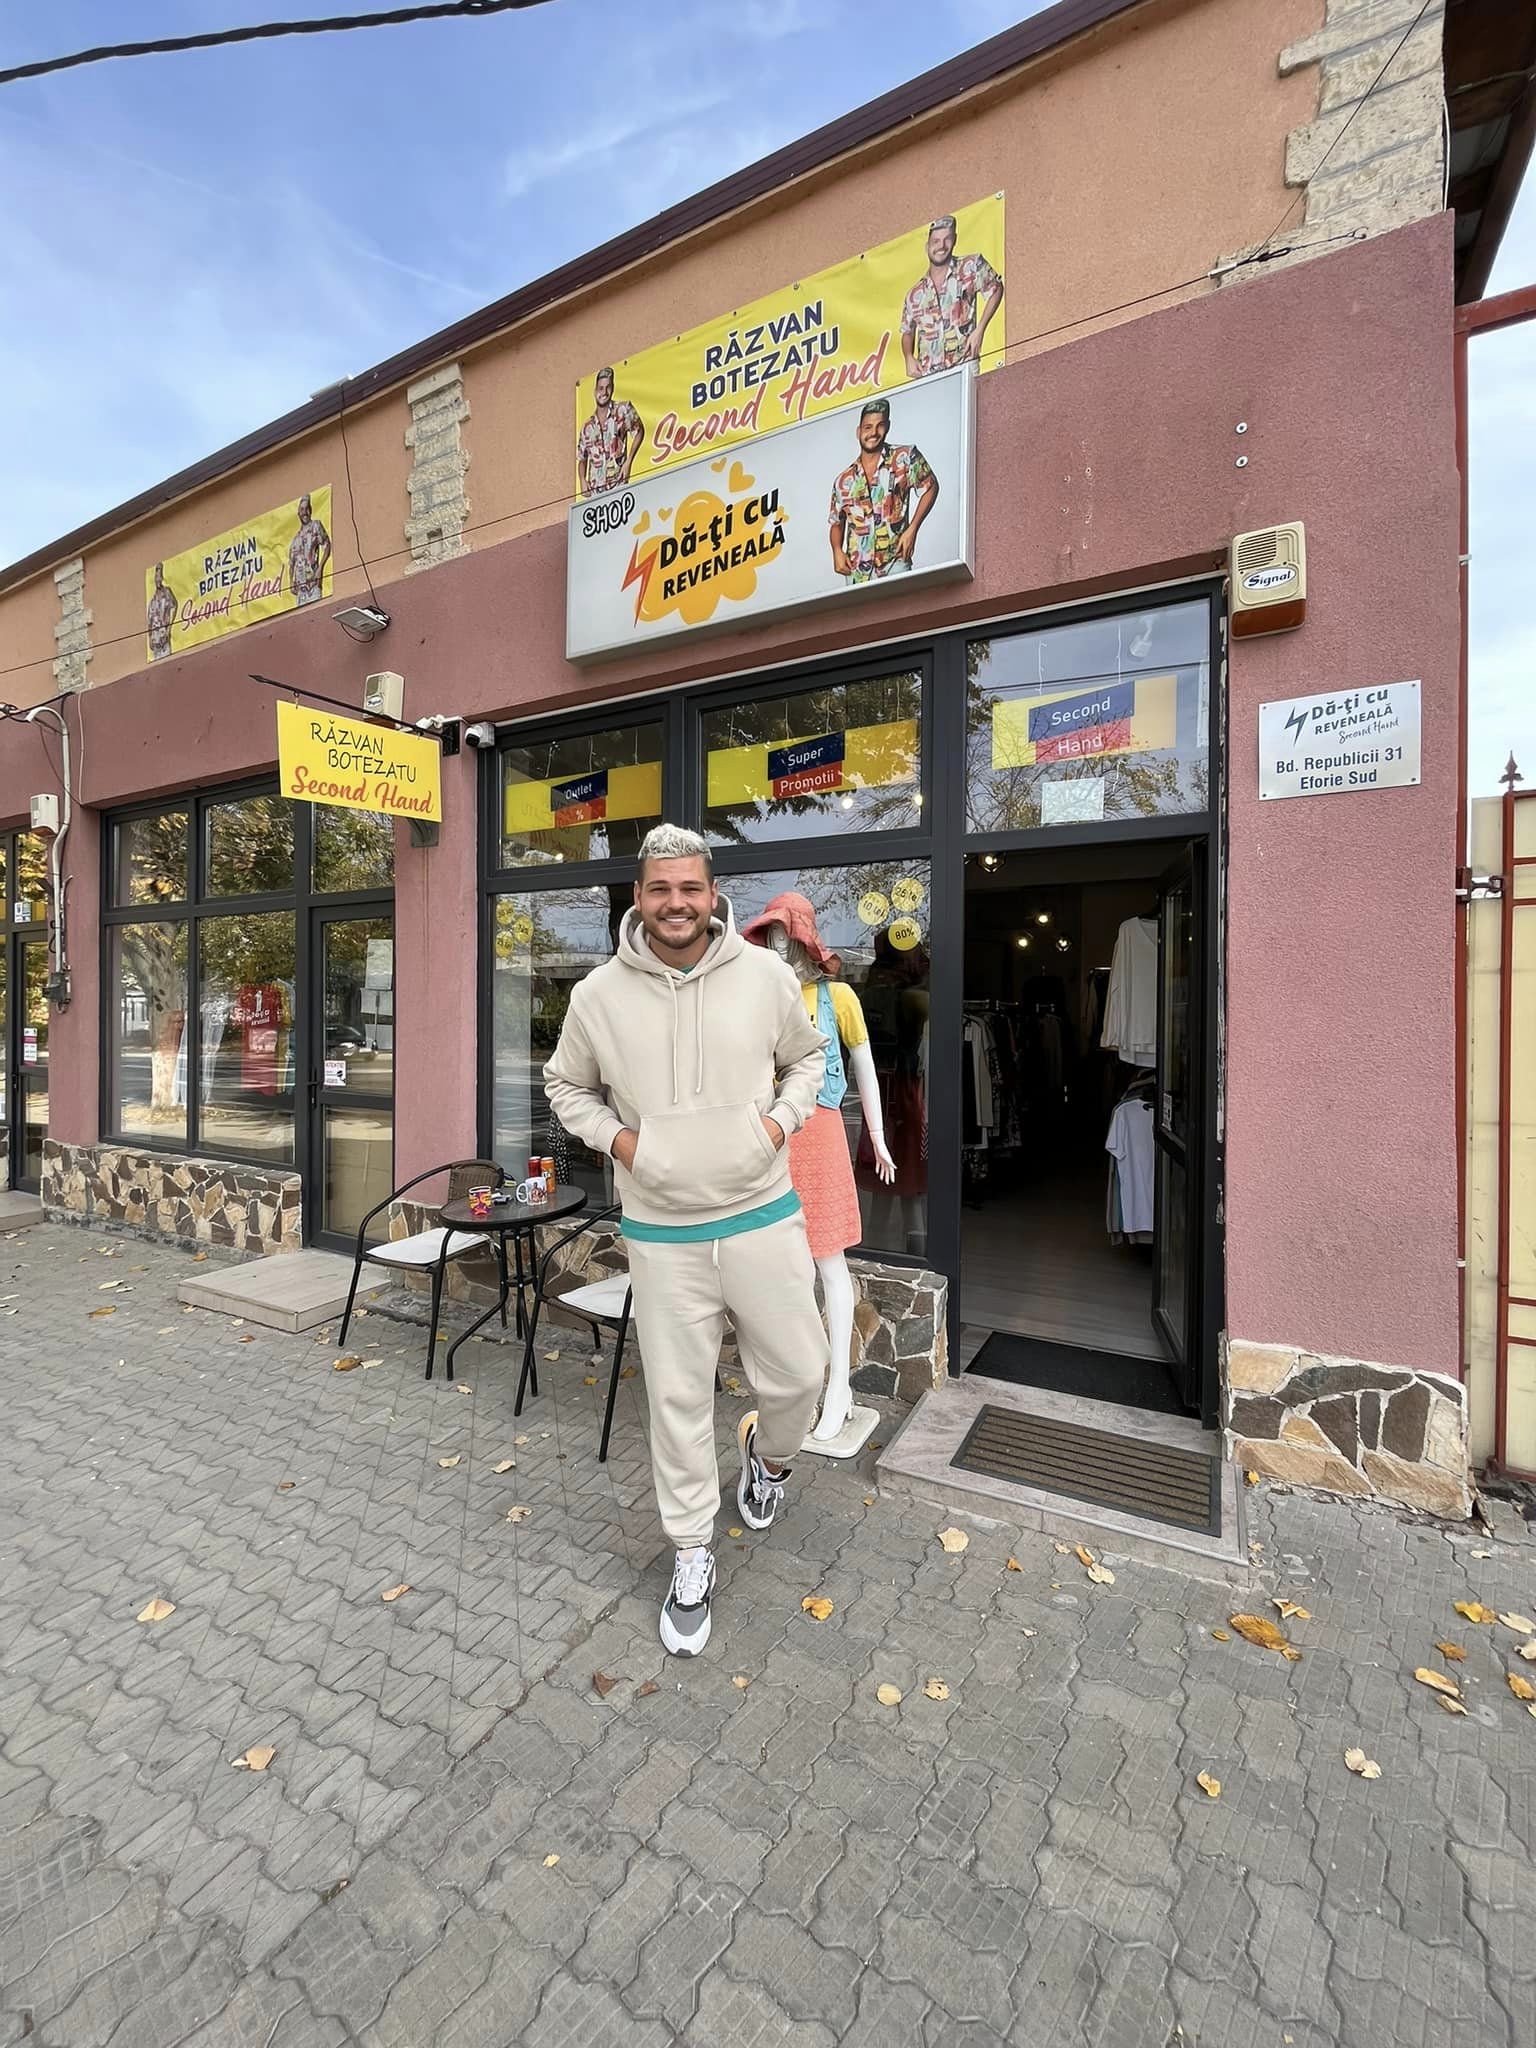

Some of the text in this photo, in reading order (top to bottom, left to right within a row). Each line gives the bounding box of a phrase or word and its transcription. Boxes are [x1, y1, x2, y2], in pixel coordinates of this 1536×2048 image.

[705, 300, 823, 373] RĂZVAN
[691, 327, 840, 408] BOTEZATU
[651, 332, 891, 464] Second Hand
[582, 491, 635, 538] SHOP
[743, 488, 779, 519] cu
[204, 536, 257, 574] RĂZVAN
[663, 518, 786, 600] REVENEALĂ
[199, 555, 263, 596] BOTEZATU
[1248, 571, 1291, 588] Signal
[181, 565, 285, 631] Second Hand
[1052, 695, 1112, 726] Second
[1366, 689, 1389, 704] cu
[1315, 703, 1393, 735] REVENEALĂ
[1338, 717, 1400, 744] Second Hand
[310, 721, 384, 756] RĂZVAN
[1058, 734, 1104, 756] Hand
[327, 748, 418, 783] BOTEZATU
[787, 746, 824, 767] Super
[1276, 746, 1404, 774] Bd. Republicii 31
[290, 765, 433, 815] Second Hand
[565, 782, 593, 801] Outlet
[779, 771, 836, 793] Promotii
[1300, 769, 1378, 790] Eforie Sud
[895, 926, 915, 940] 80%
